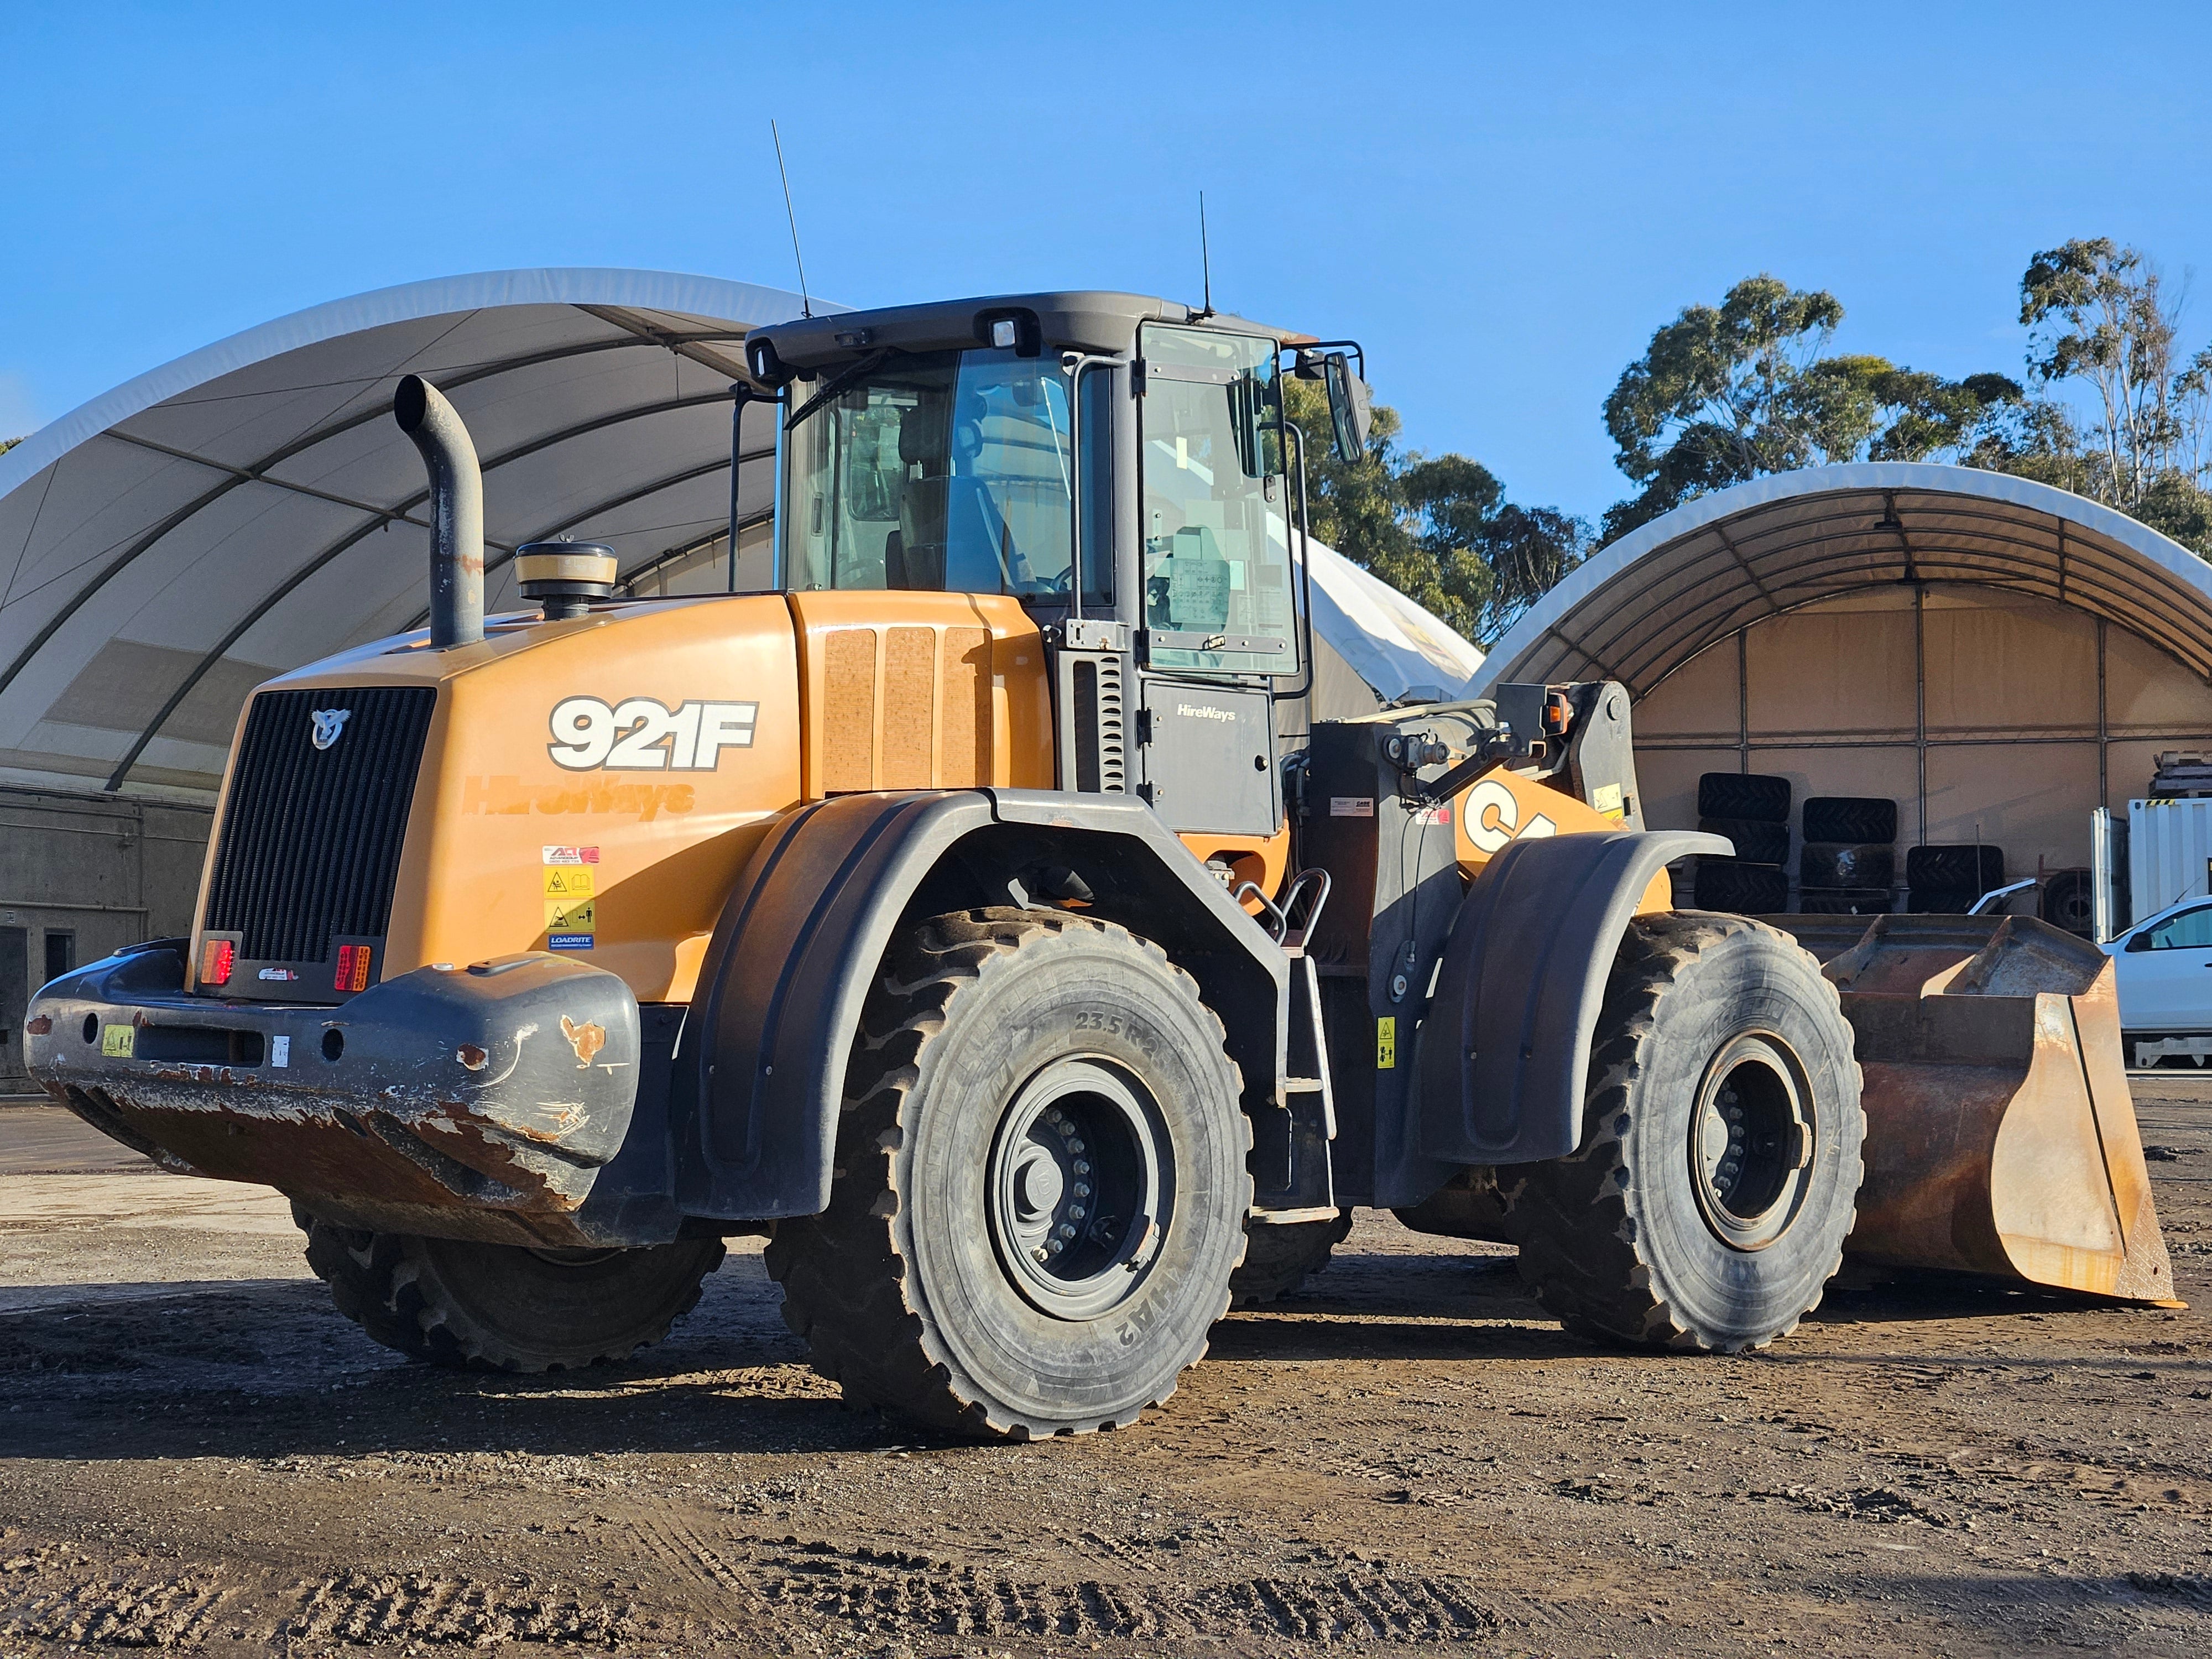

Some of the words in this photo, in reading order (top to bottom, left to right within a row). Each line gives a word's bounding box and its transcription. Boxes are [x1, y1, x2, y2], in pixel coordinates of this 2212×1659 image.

[547, 695, 760, 772] 921F
[1177, 703, 1235, 722] HireWays
[1114, 1266, 1181, 1346] XHA2
